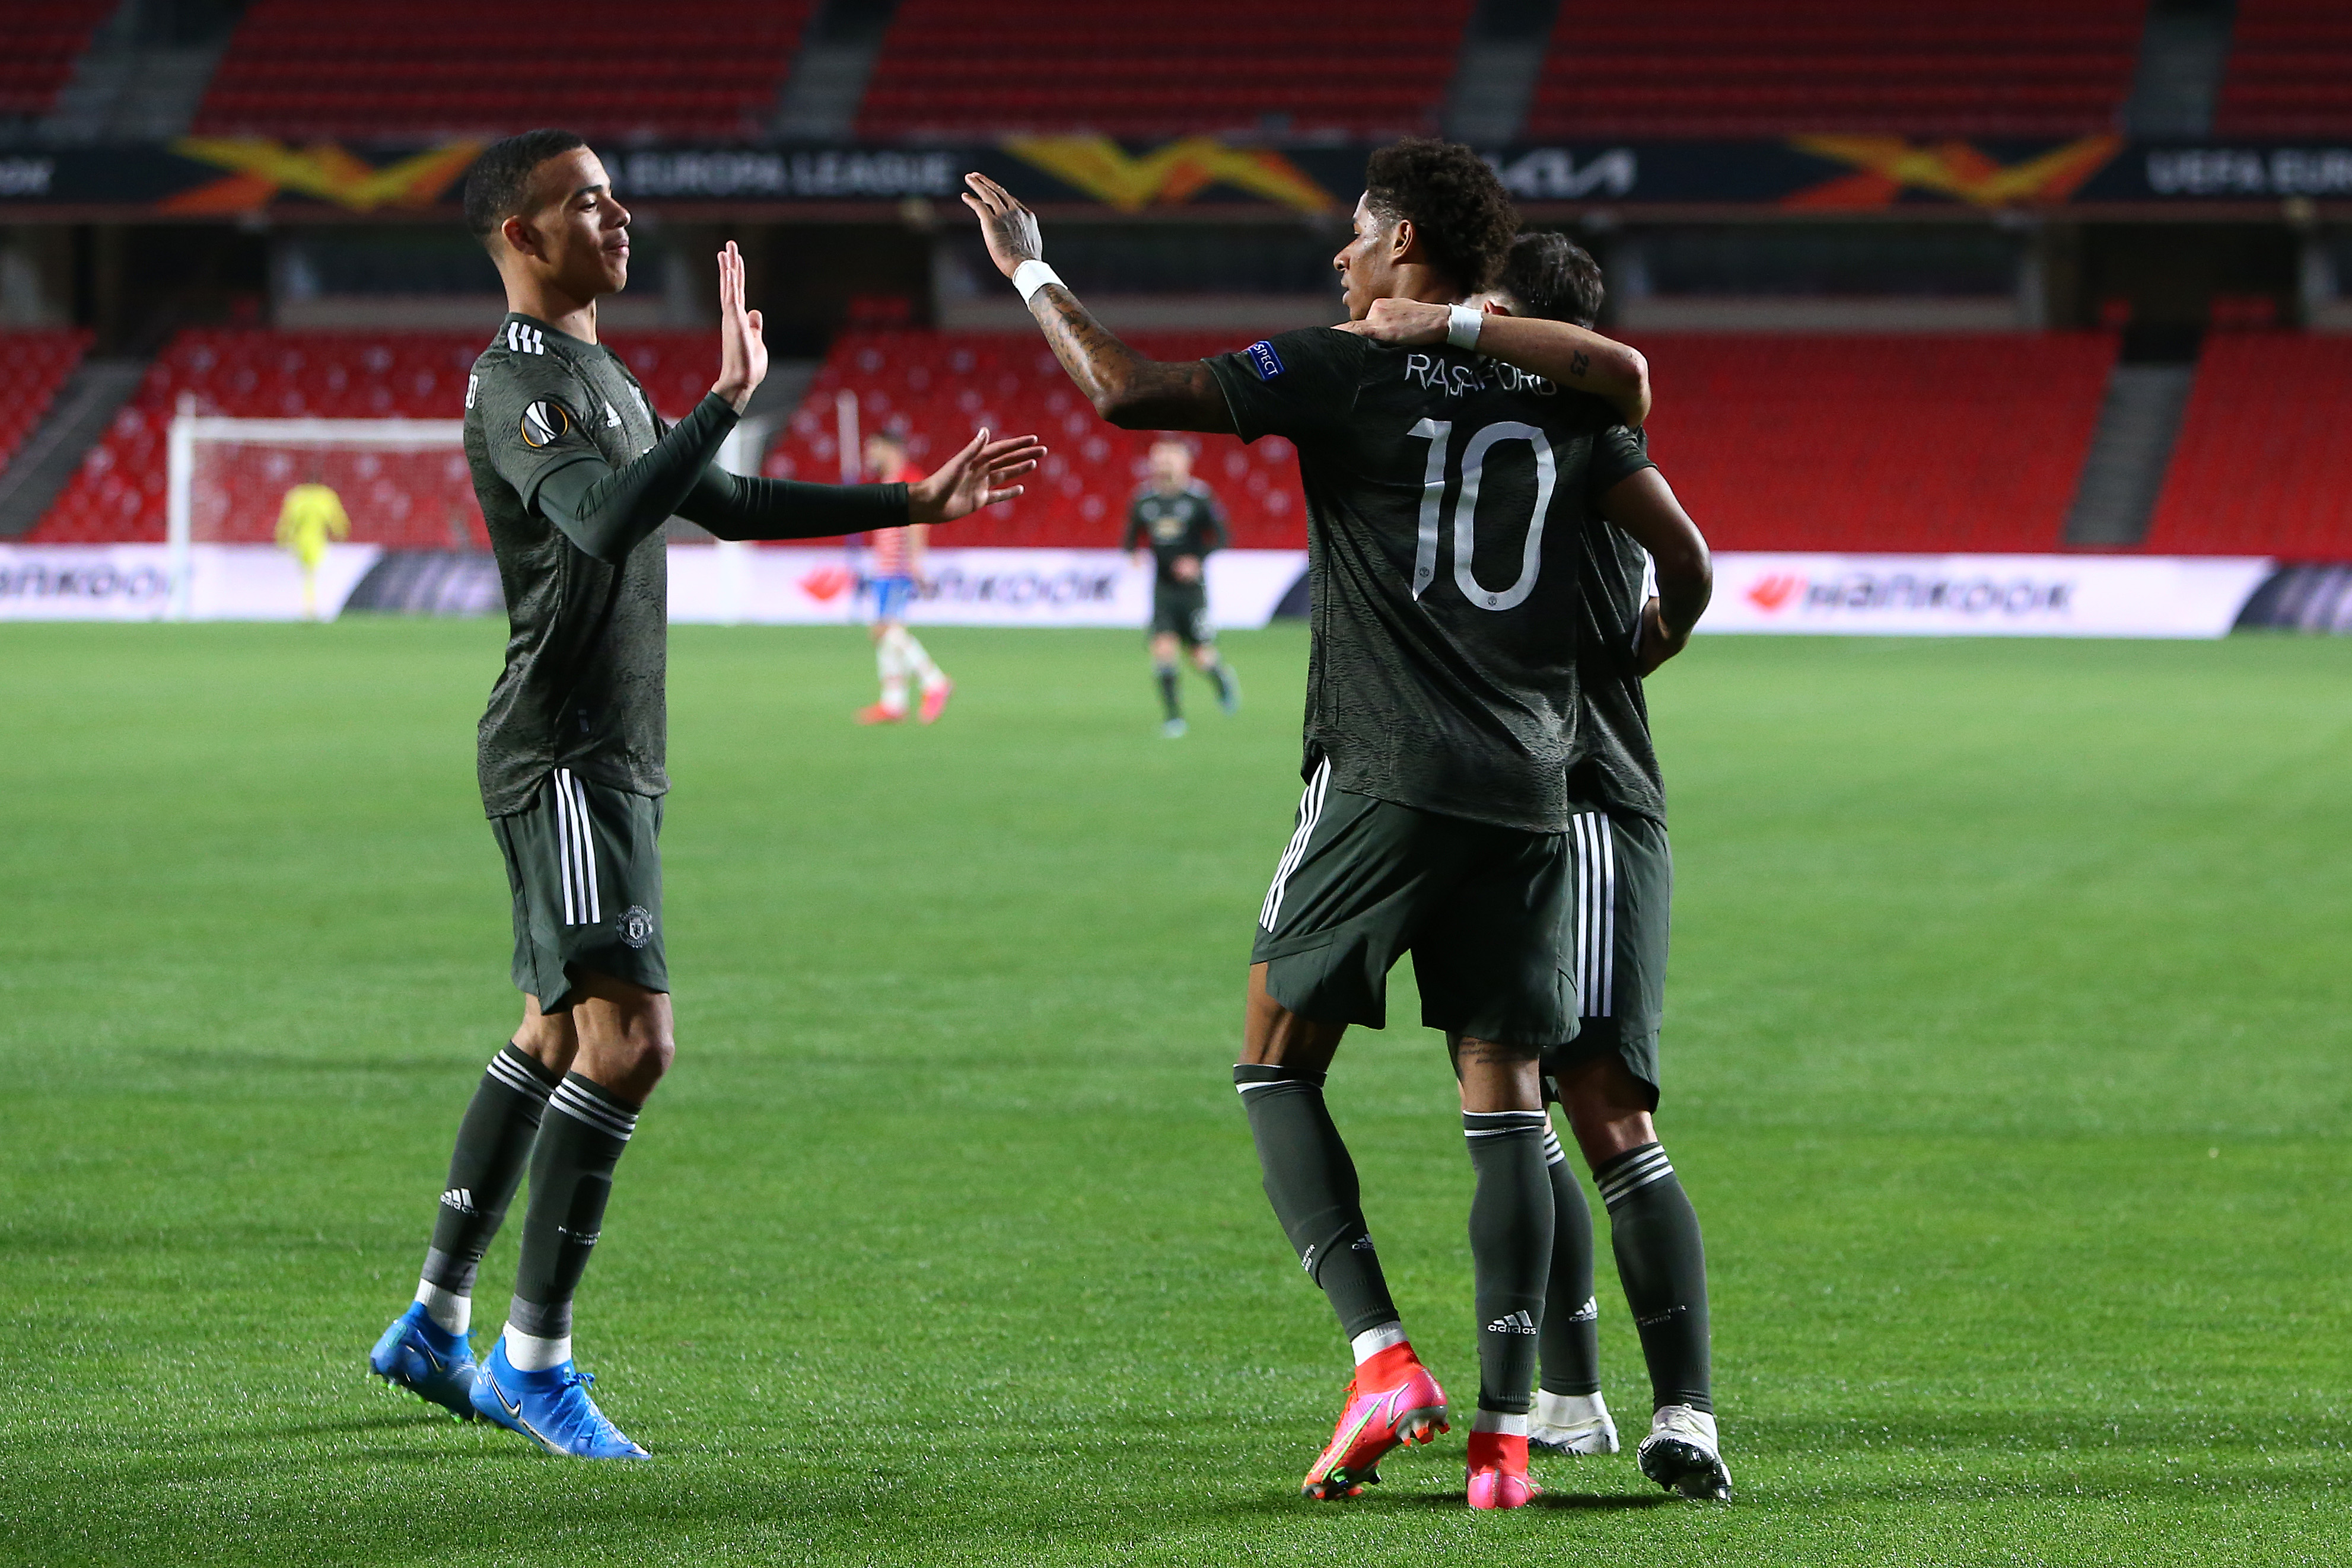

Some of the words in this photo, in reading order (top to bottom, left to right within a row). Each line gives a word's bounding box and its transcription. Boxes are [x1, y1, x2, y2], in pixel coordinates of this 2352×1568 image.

[791, 150, 950, 196] LEAGUE
[1407, 418, 1557, 611] 10
[1488, 1324, 1536, 1335] adidas
